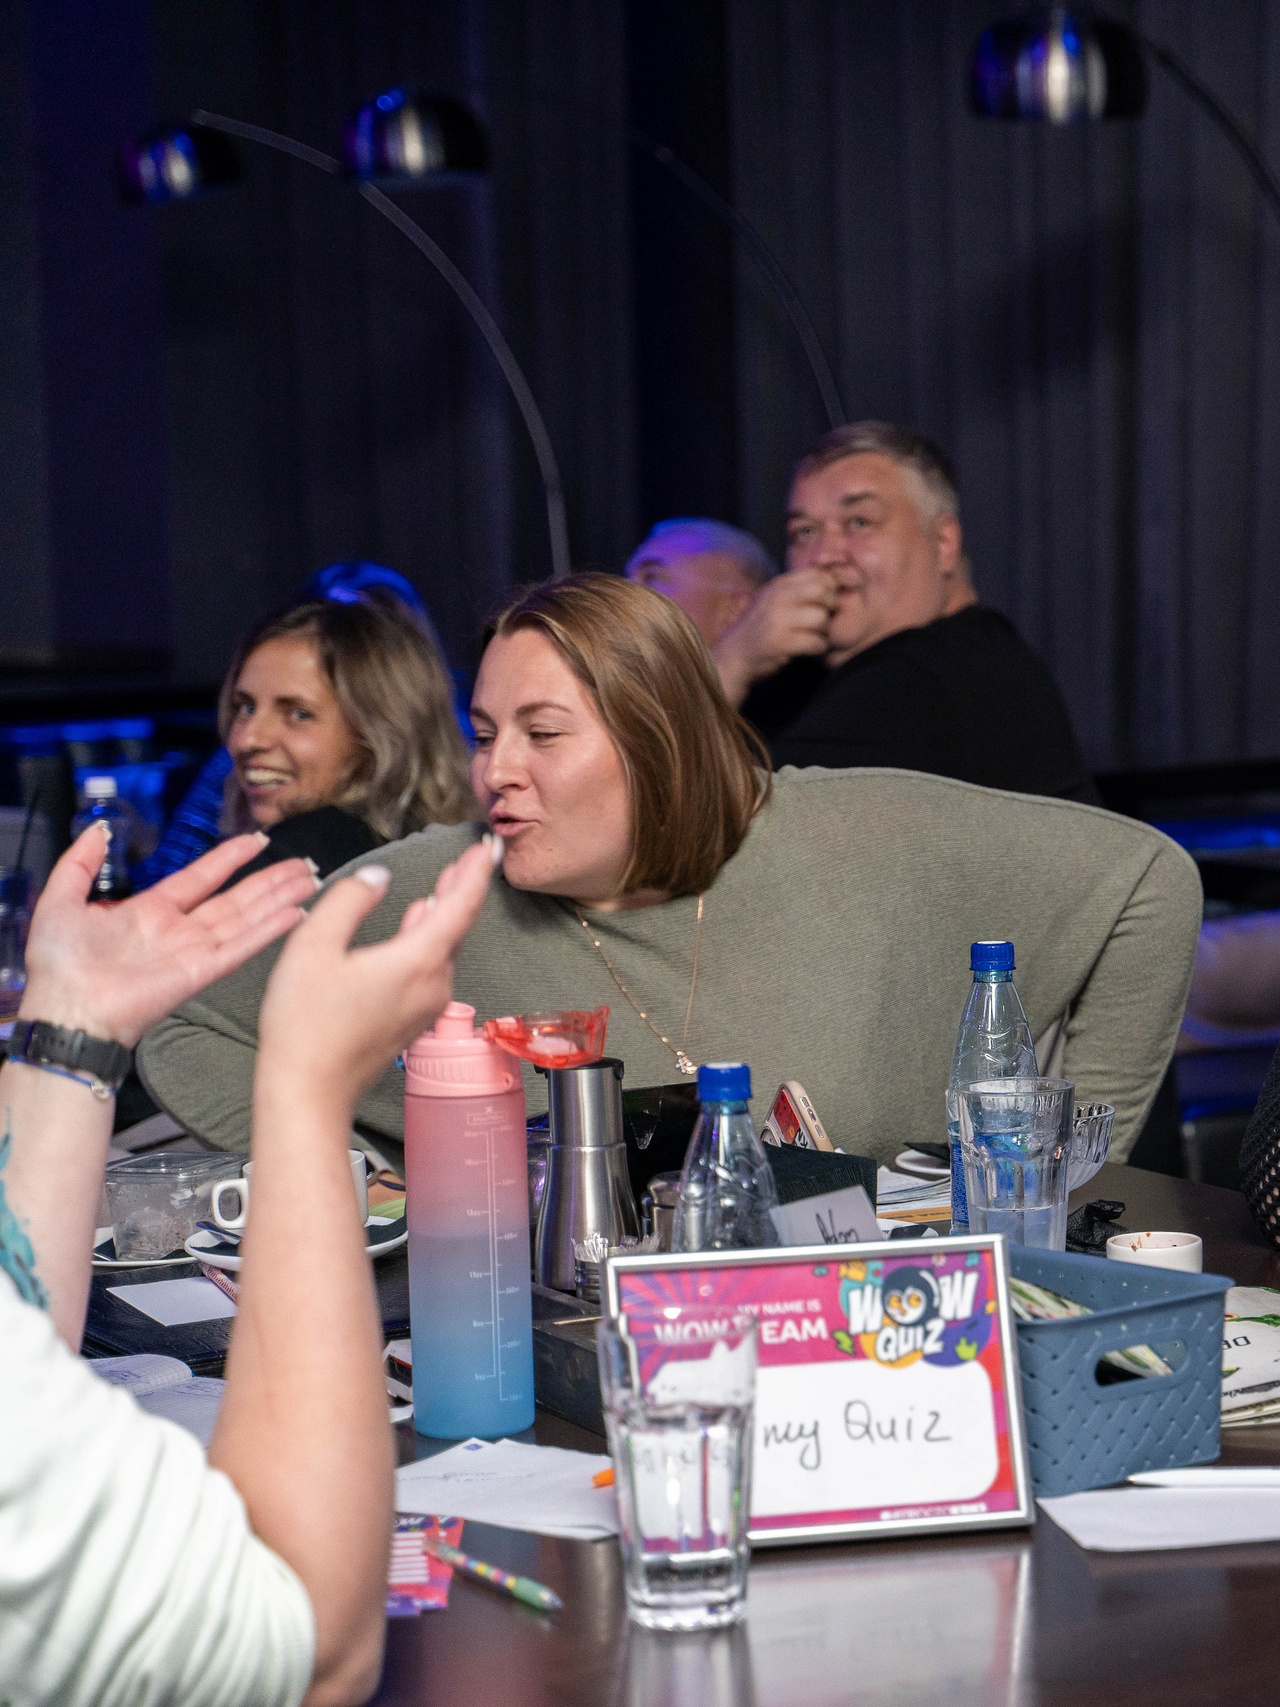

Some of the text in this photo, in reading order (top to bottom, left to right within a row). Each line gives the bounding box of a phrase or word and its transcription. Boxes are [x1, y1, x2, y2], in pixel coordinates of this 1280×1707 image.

[762, 1300, 804, 1315] NAME
[807, 1298, 822, 1313] IS
[875, 1318, 946, 1363] QUIZ
[844, 1399, 953, 1445] Quiz
